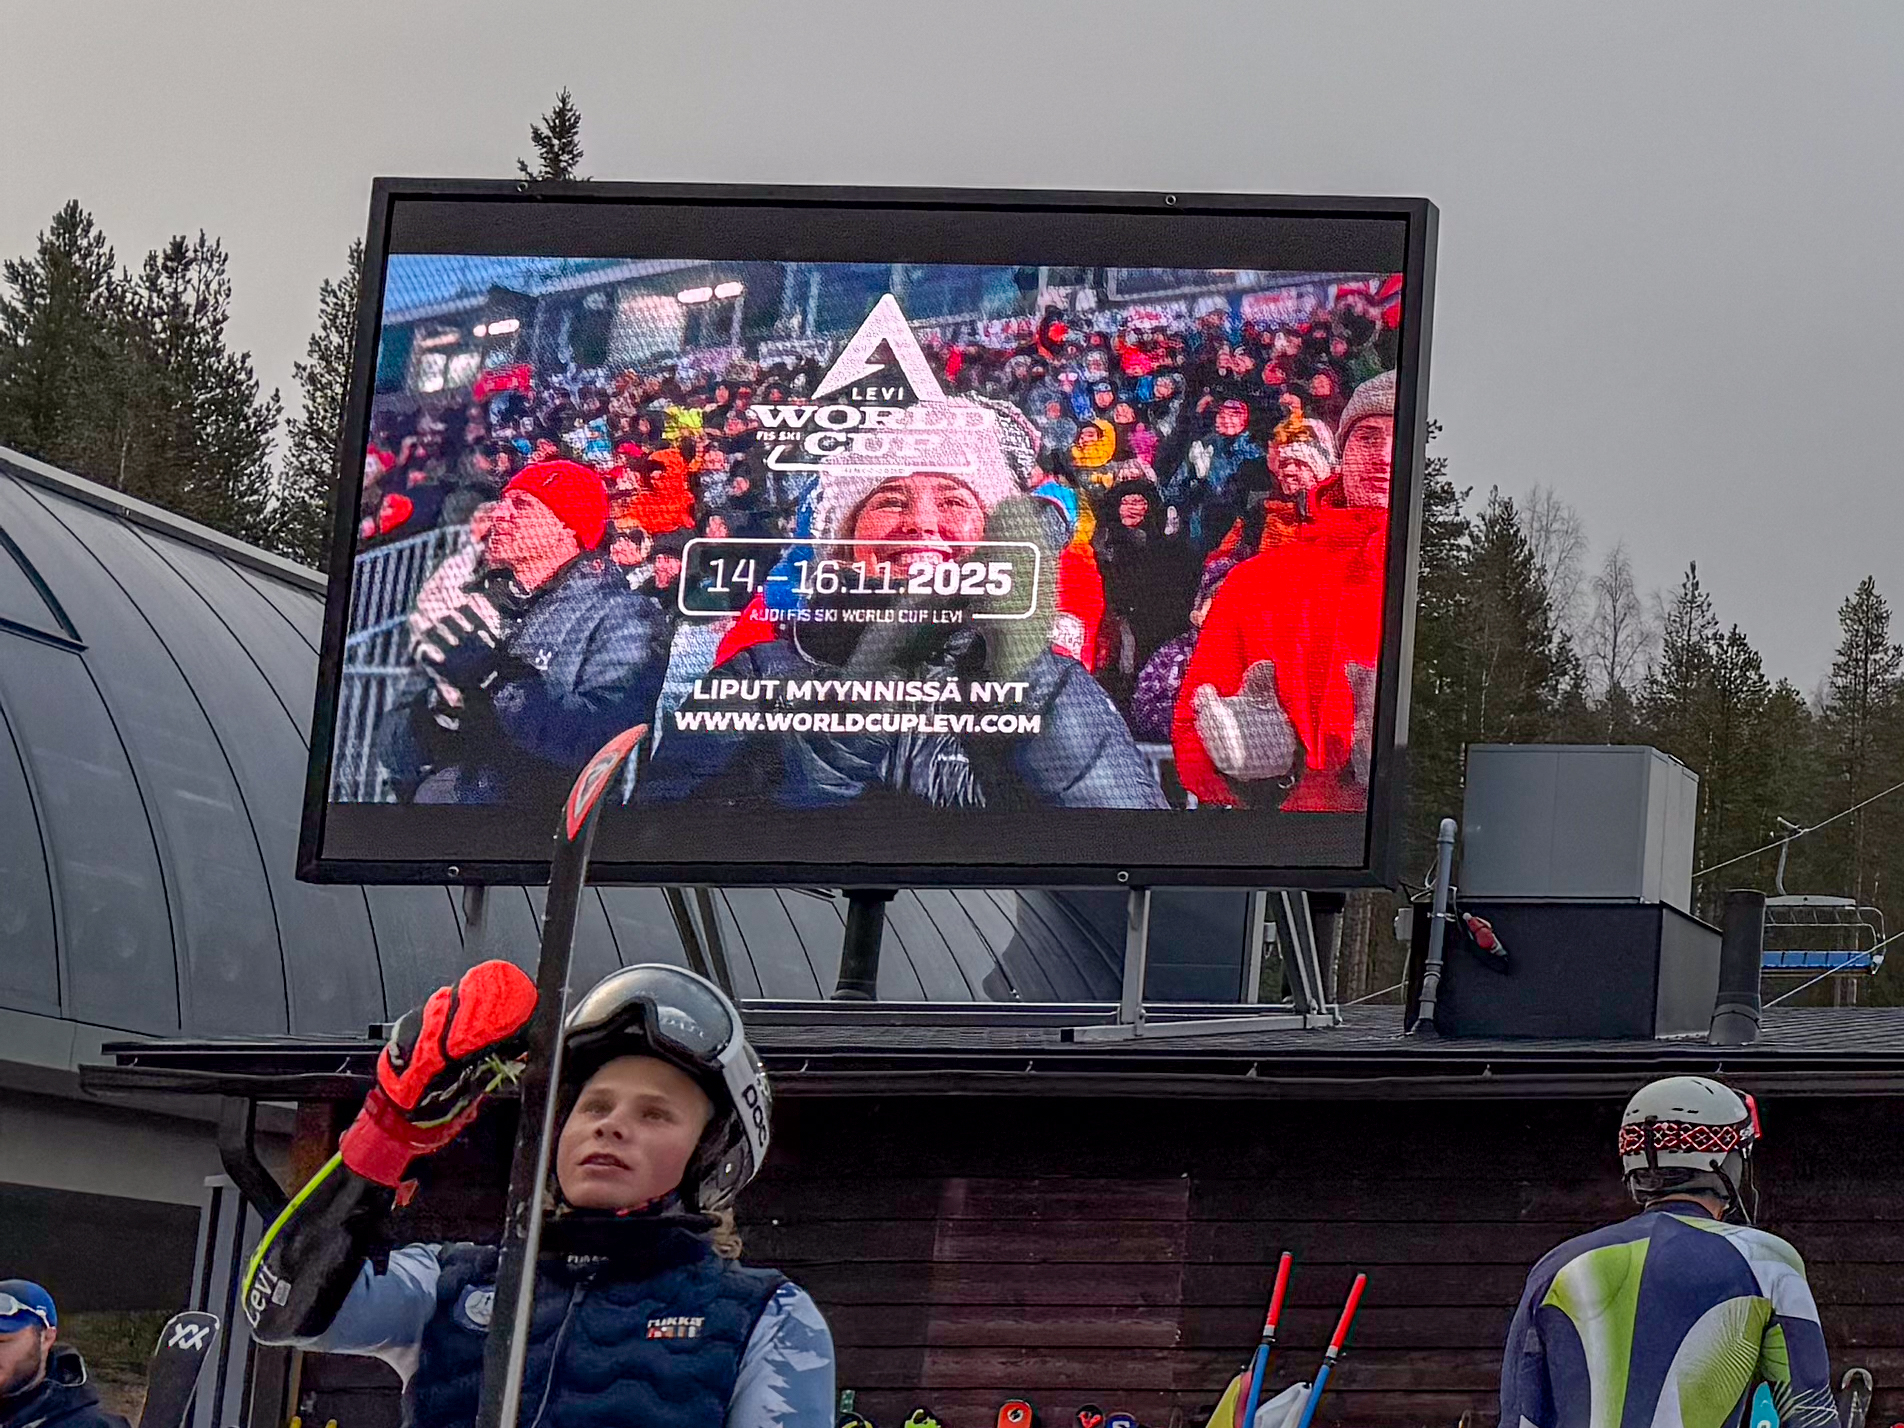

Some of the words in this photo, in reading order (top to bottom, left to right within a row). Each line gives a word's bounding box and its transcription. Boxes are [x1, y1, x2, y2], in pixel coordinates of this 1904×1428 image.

[851, 386, 904, 401] LEVI
[750, 404, 995, 430] WORLD
[803, 431, 946, 457] CUP
[814, 609, 838, 622] SKI
[842, 610, 894, 623] WORLD
[932, 610, 963, 623] LEVI
[693, 679, 781, 701] LIPUT
[786, 676, 962, 703] MYYNNISSÄ
[969, 681, 1029, 704] NYT
[674, 710, 1041, 734] WWW.WORLDCUPLEVI.COM
